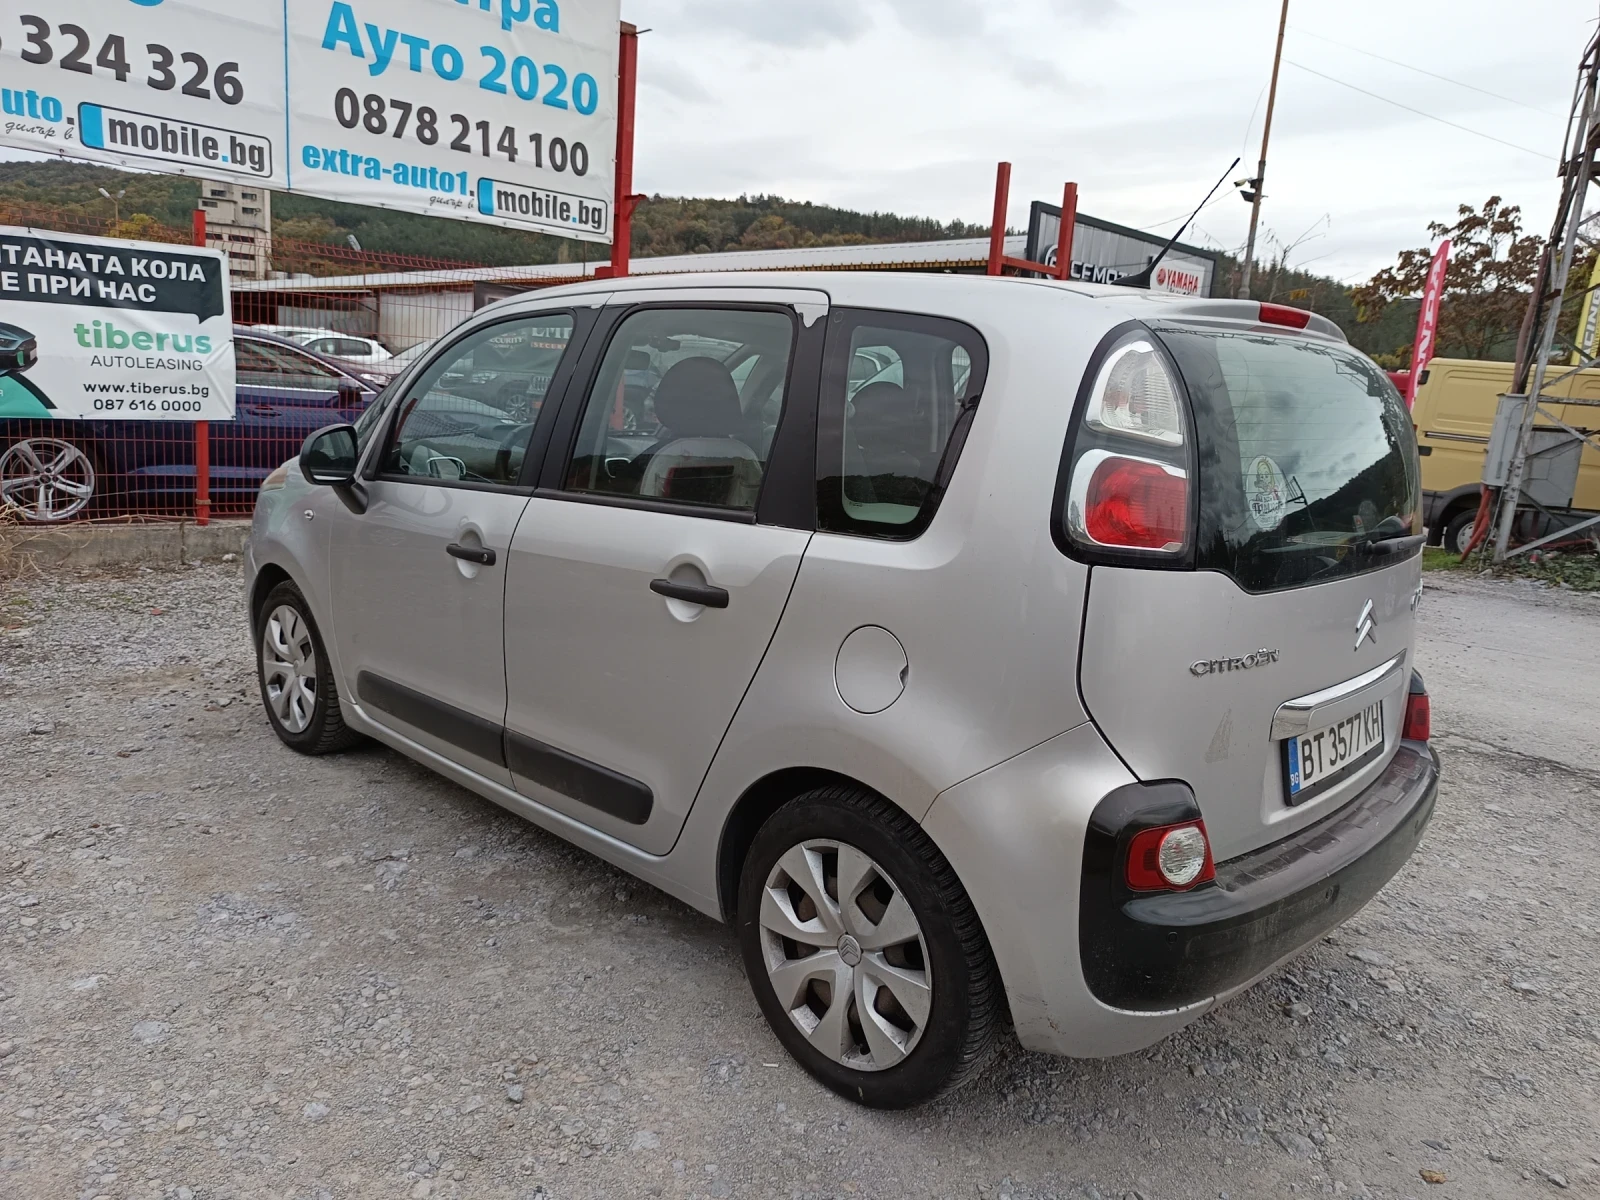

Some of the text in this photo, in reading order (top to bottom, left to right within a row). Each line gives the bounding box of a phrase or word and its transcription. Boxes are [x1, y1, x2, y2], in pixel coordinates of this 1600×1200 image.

[19, 14, 244, 105] 324 326
[321, 1, 599, 116] Ауто 2020
[108, 117, 265, 173] mobile.bg
[334, 87, 589, 177] 0878 214 100
[302, 144, 603, 229] extra-auto1. mobile.bg
[0, 244, 207, 283] ТАНАТА КОЛА
[1167, 267, 1199, 293] YAMAHA
[1, 271, 157, 303] Е ПРИ НАС
[73, 319, 213, 355] tiberus
[90, 355, 203, 371] AUTOLEASING
[83, 382, 209, 398] www.tiberus.bg
[93, 398, 202, 412] 087 616 0000
[1190, 647, 1280, 678] CITROËN
[1301, 701, 1381, 782] BT 3577 KH
[1290, 771, 1300, 787] BG
